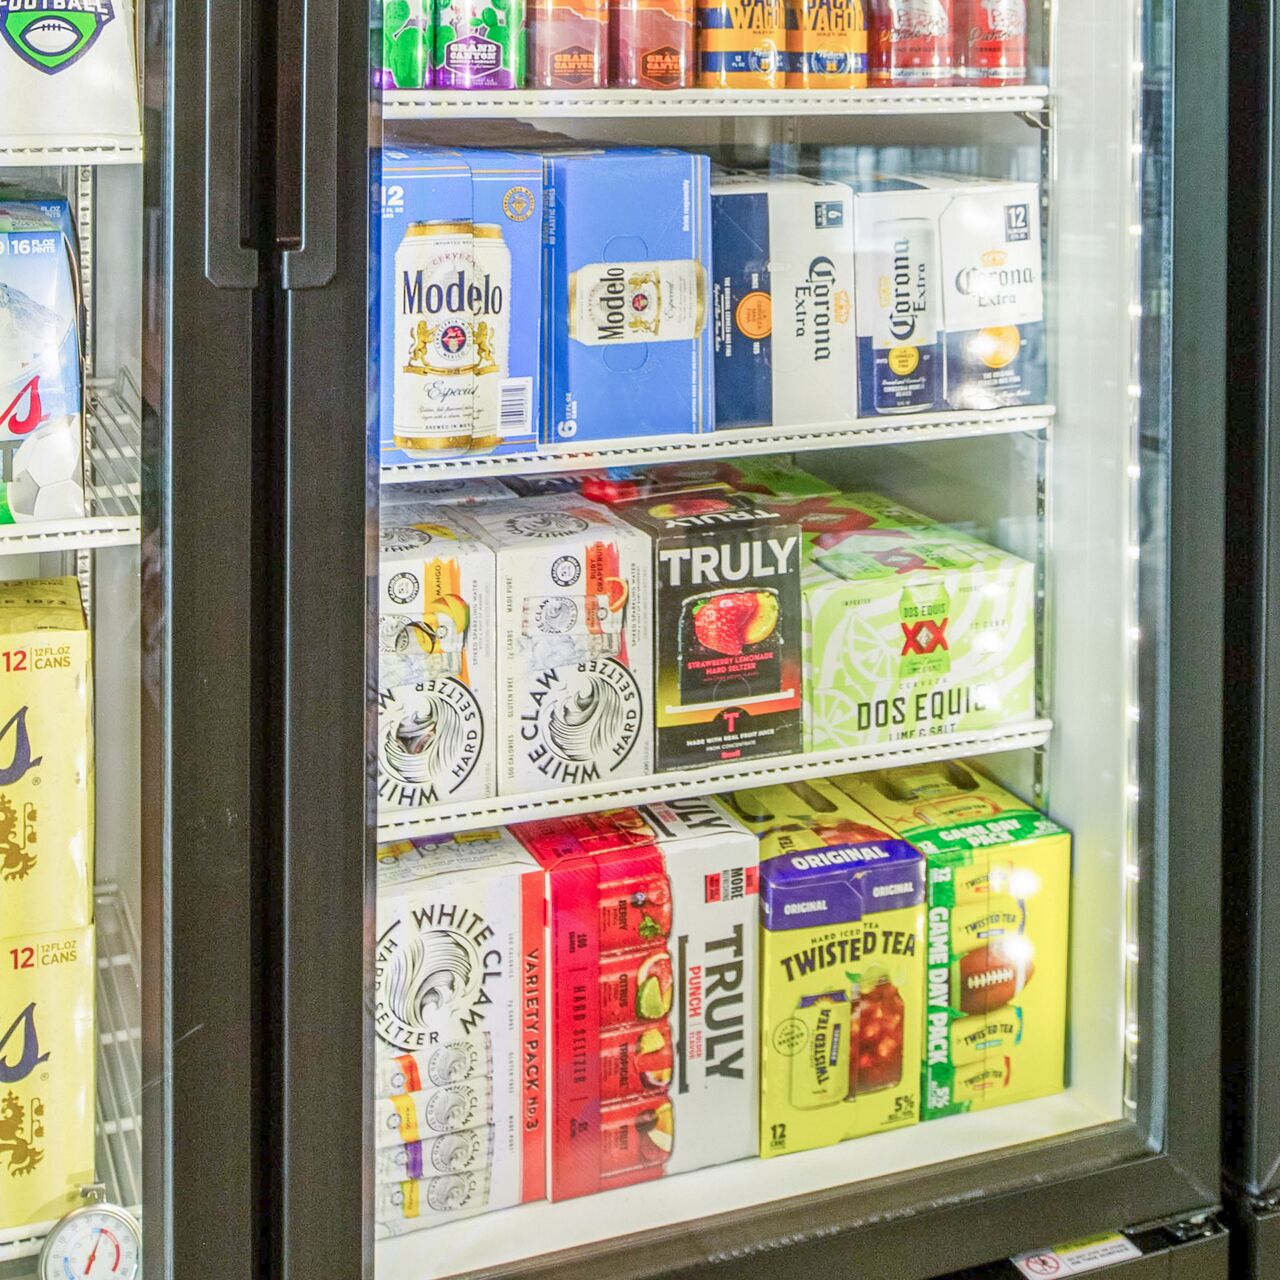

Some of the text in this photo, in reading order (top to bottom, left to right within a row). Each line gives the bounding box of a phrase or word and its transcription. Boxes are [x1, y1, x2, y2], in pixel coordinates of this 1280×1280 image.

[450, 44, 497, 53] GRAND
[450, 51, 497, 60] CANYON
[11, 240, 30, 254] 16
[31, 245, 56, 254] PINTS
[403, 270, 502, 316] Modelo
[598, 267, 625, 341] Modelo
[796, 286, 811, 337] Extra
[809, 256, 836, 361] Corona
[424, 380, 477, 402] Especial
[660, 537, 794, 586] TRULY
[903, 604, 946, 618] DOS EQUIS
[900, 618, 949, 656] XX
[2, 650, 28, 673] 12
[34, 656, 71, 670] CANS
[687, 651, 774, 670] STRAWBERRY LEMONADE
[521, 668, 602, 784] WHITE CLAW
[578, 660, 637, 758] HARD SELTZER
[791, 845, 889, 871] ORIGINAL
[784, 900, 828, 915] ORIGINAL
[811, 935, 836, 944] HARD
[839, 929, 861, 938] ICED
[781, 930, 916, 982] TWISTED TEA
[689, 965, 702, 1019] PUNCH
[704, 923, 744, 1080] TRULY
[929, 906, 948, 1065] GAME DAY PACK
[525, 948, 540, 1091] VARIETY PACK
